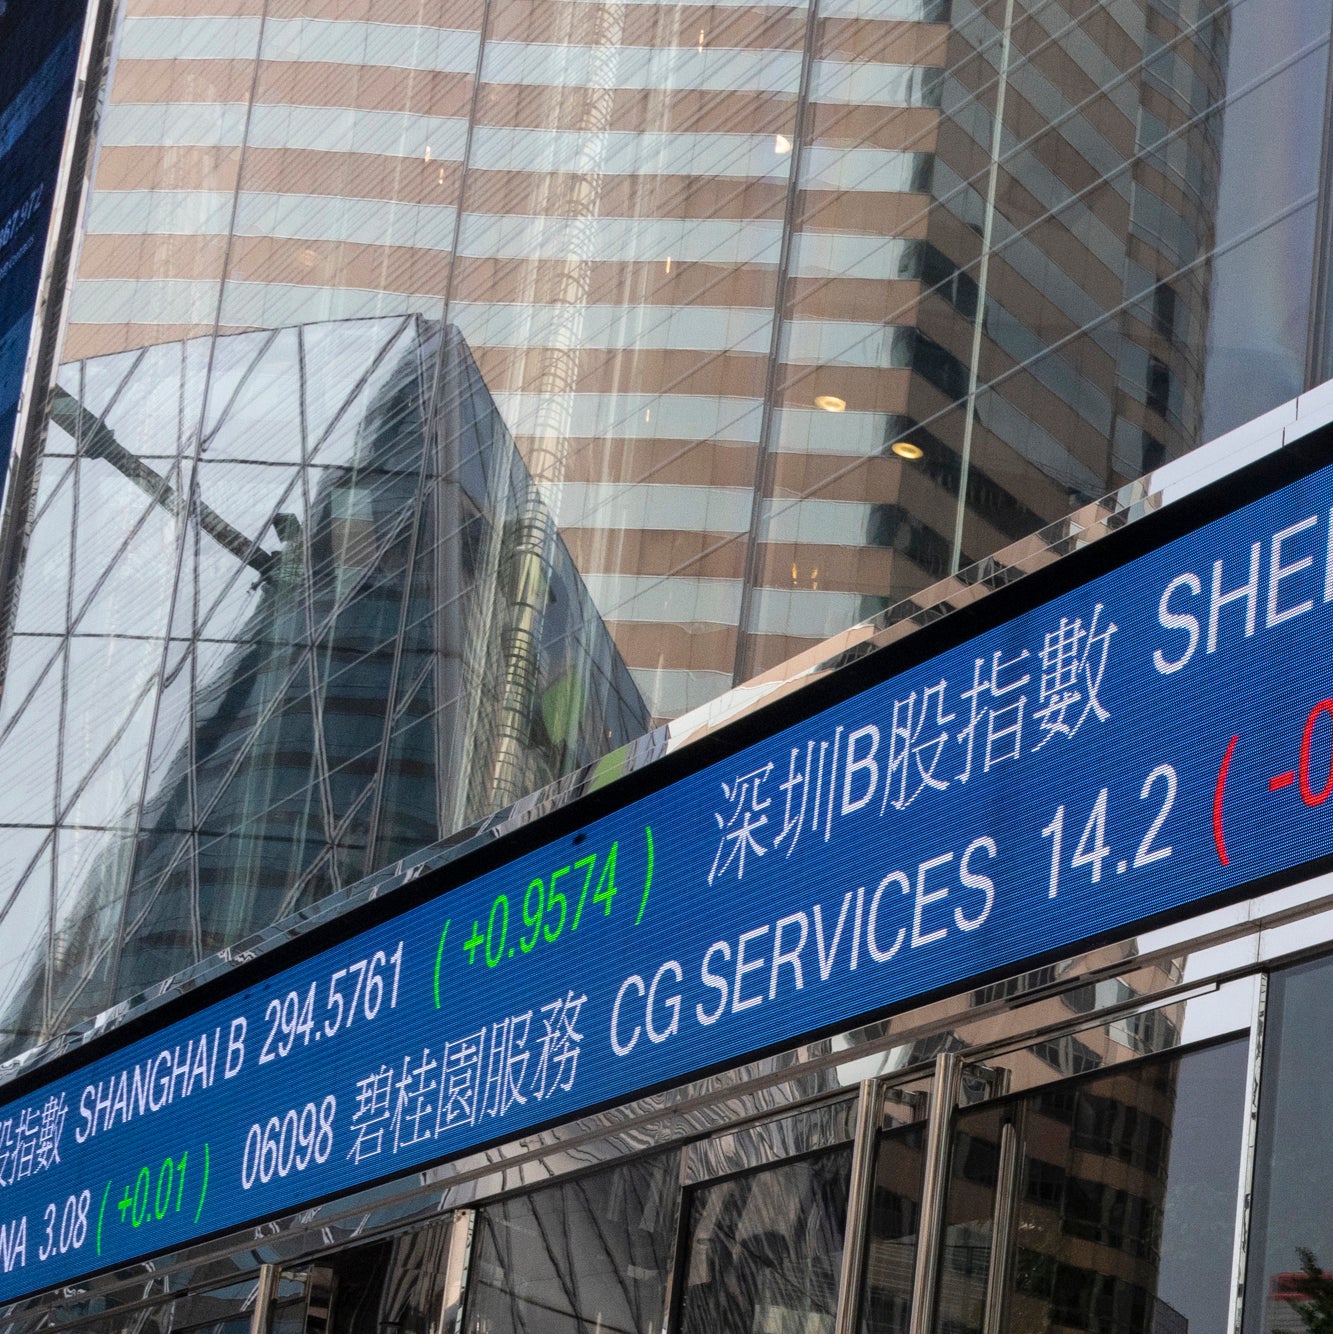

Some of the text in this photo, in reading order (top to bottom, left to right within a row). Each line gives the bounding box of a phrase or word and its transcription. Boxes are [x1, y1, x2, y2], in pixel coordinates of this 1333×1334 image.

[39, 1189, 91, 1261] 3.08
[242, 1095, 337, 1190] 06098
[346, 990, 588, 1165] 碧桂園服務
[611, 960, 684, 1057] CG
[696, 836, 998, 1027] SERVICES
[1041, 763, 1178, 899] 14.2
[75, 1034, 219, 1143] SHANGHAI
[225, 1016, 248, 1080] B
[258, 941, 405, 1065] 294.5761
[708, 602, 1118, 887] 深圳B股指數
